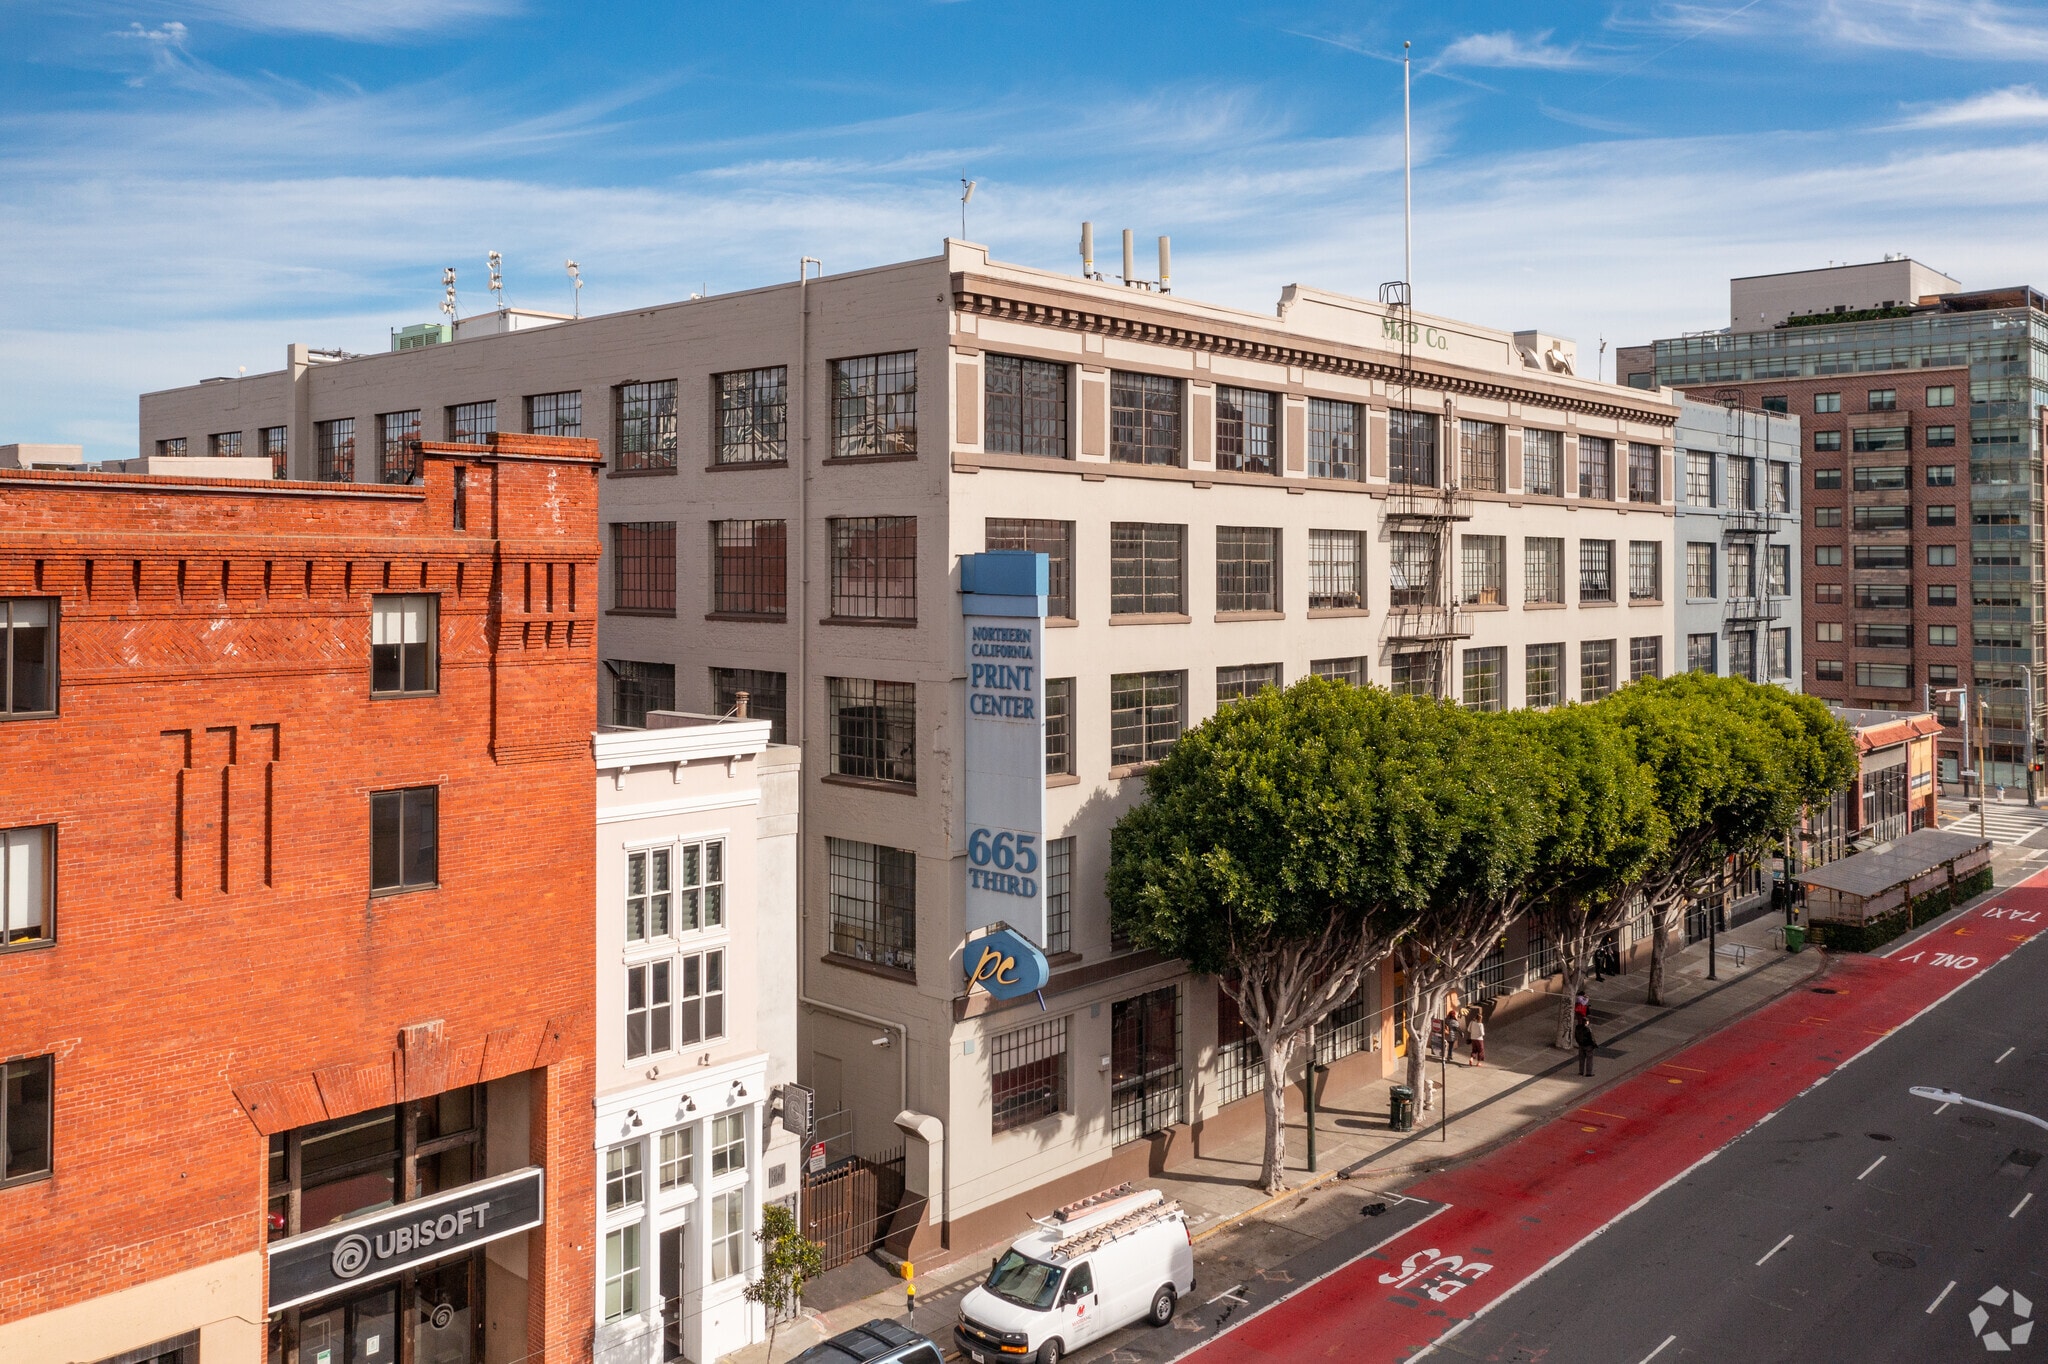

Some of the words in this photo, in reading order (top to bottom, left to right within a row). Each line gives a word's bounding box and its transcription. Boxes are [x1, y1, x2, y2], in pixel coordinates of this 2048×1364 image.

[1426, 327, 1449, 351] Co.
[972, 626, 1032, 643] NORTHERN
[971, 643, 1033, 659] CALIFORNIA
[971, 663, 1034, 691] PRINT
[970, 693, 1035, 719] CENTER
[968, 828, 1039, 874] 665
[968, 867, 1038, 898] THIRD
[1981, 907, 2042, 923] TAXI
[1898, 951, 1980, 969] ONLY
[376, 1201, 490, 1259] UBISOFT
[1378, 1248, 1495, 1302] BUS
